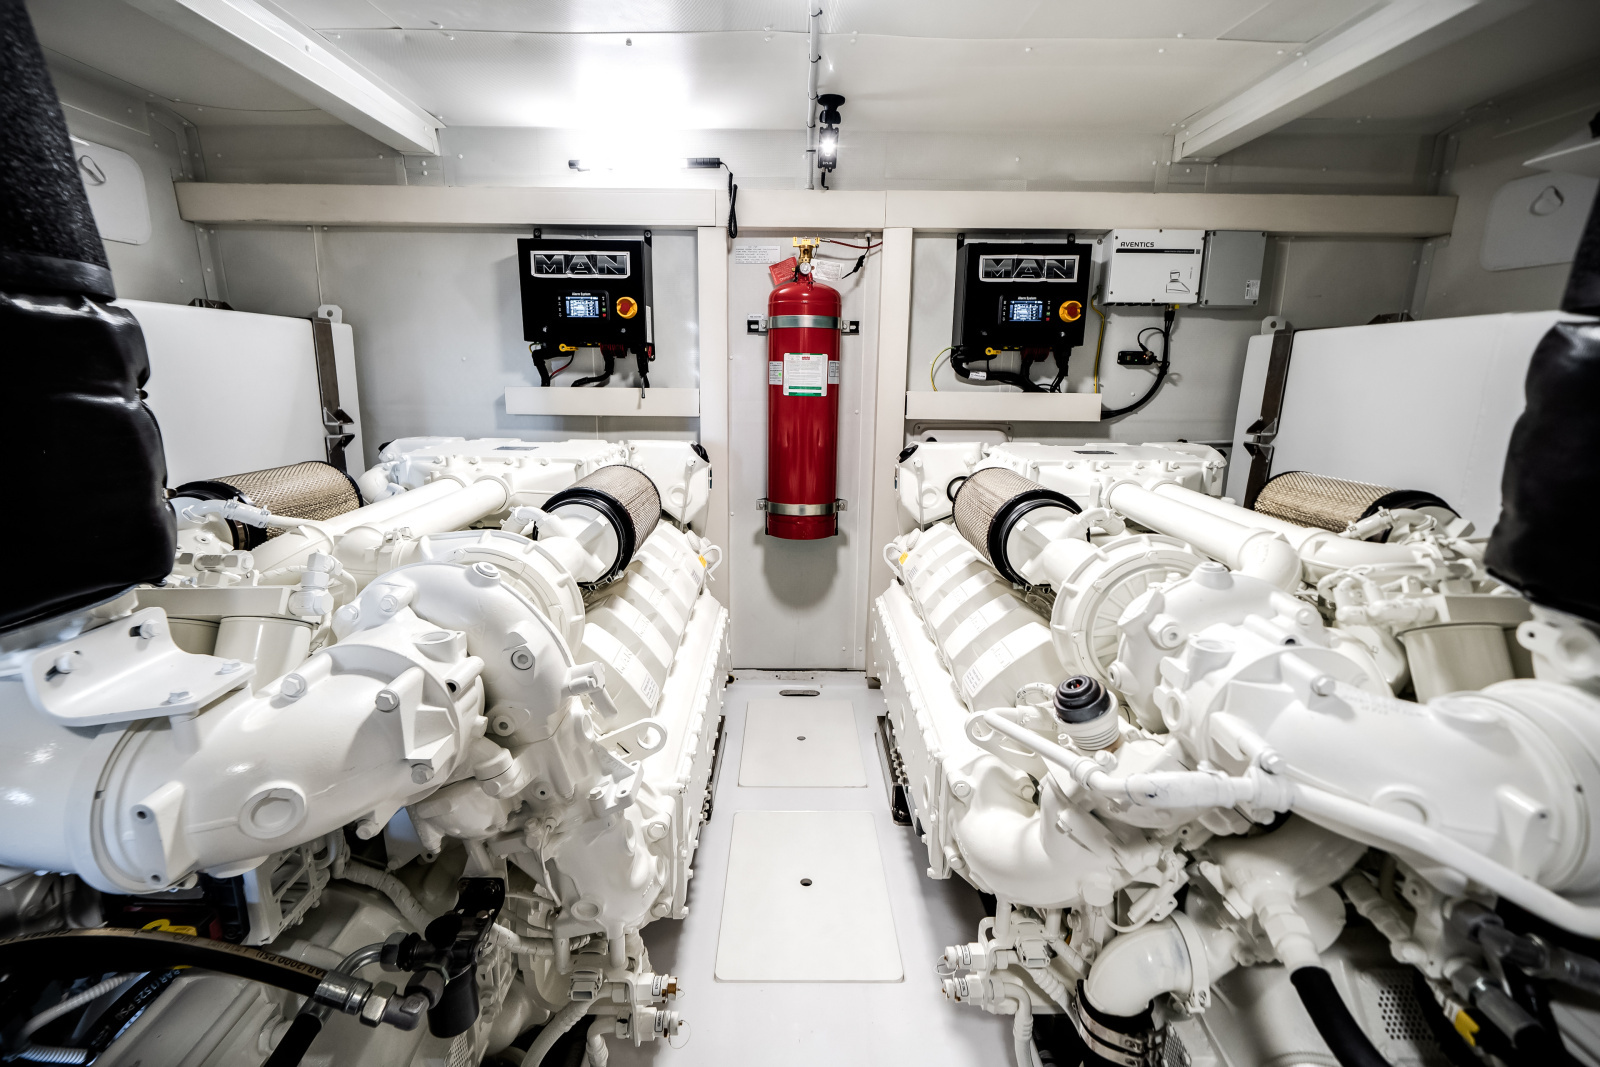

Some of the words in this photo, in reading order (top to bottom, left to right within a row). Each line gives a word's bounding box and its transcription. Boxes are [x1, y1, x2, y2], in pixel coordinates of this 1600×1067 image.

[533, 252, 629, 276] MAN
[981, 257, 1077, 280] MAN
[277, 956, 308, 972] (2000
